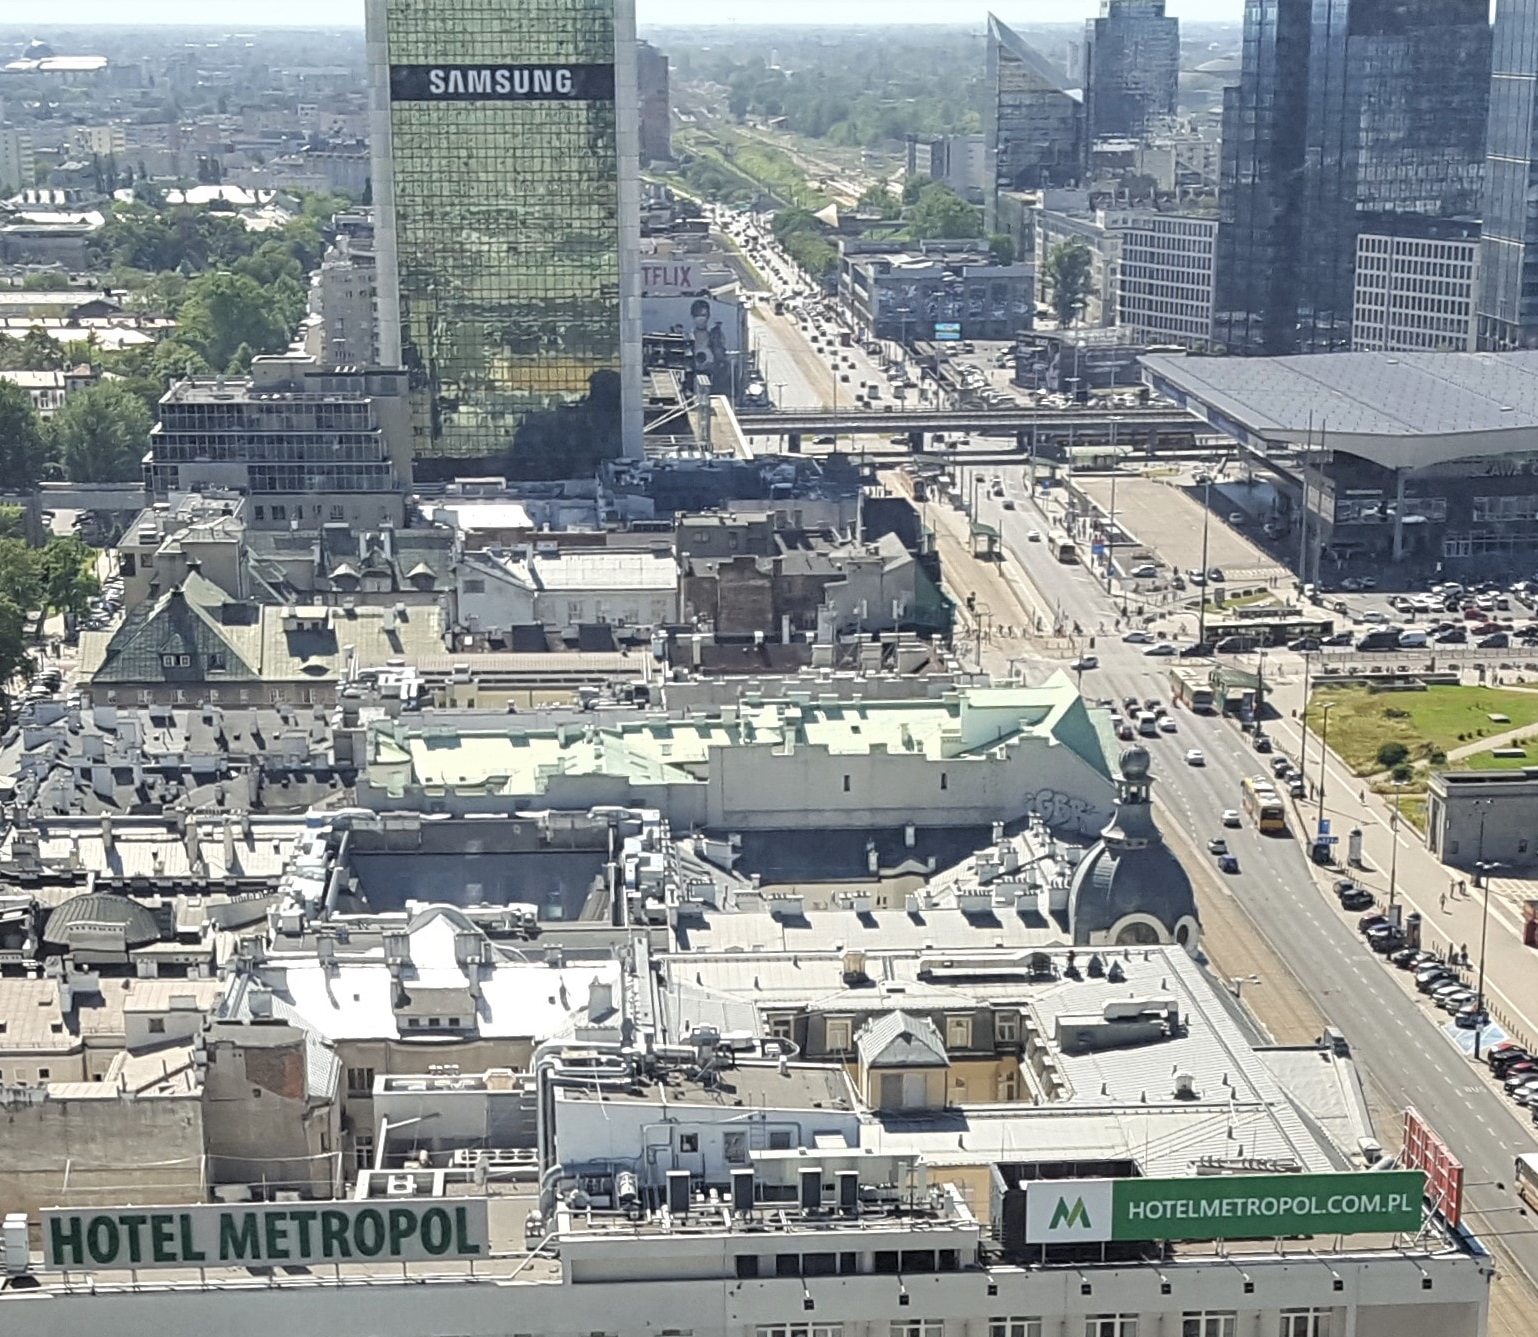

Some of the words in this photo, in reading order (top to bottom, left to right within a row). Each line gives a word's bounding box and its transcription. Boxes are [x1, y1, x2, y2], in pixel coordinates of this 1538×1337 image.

[429, 69, 573, 94] SAMSUNG
[641, 266, 692, 287] TFLIX
[1128, 1193, 1412, 1220] HOTELMETROPOL.COM.PL
[49, 1213, 205, 1265] HOTEL
[219, 1206, 480, 1260] METROPOL
